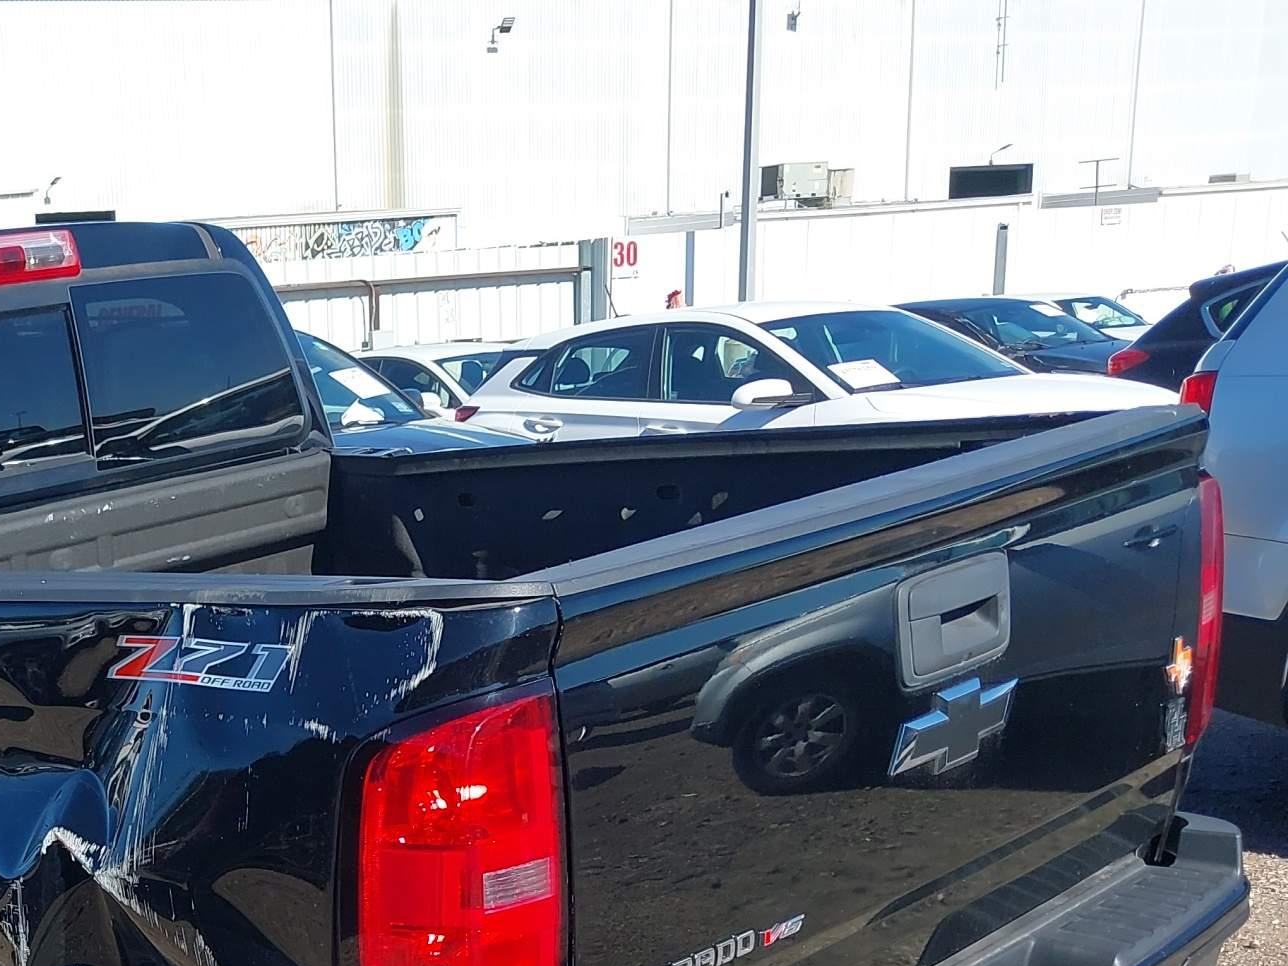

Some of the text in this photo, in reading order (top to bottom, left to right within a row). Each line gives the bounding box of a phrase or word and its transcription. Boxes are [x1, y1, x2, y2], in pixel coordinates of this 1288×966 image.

[613, 241, 638, 267] 30
[107, 635, 295, 683] Z71
[200, 677, 272, 691] OFF ROAD
[759, 913, 806, 947] V6
